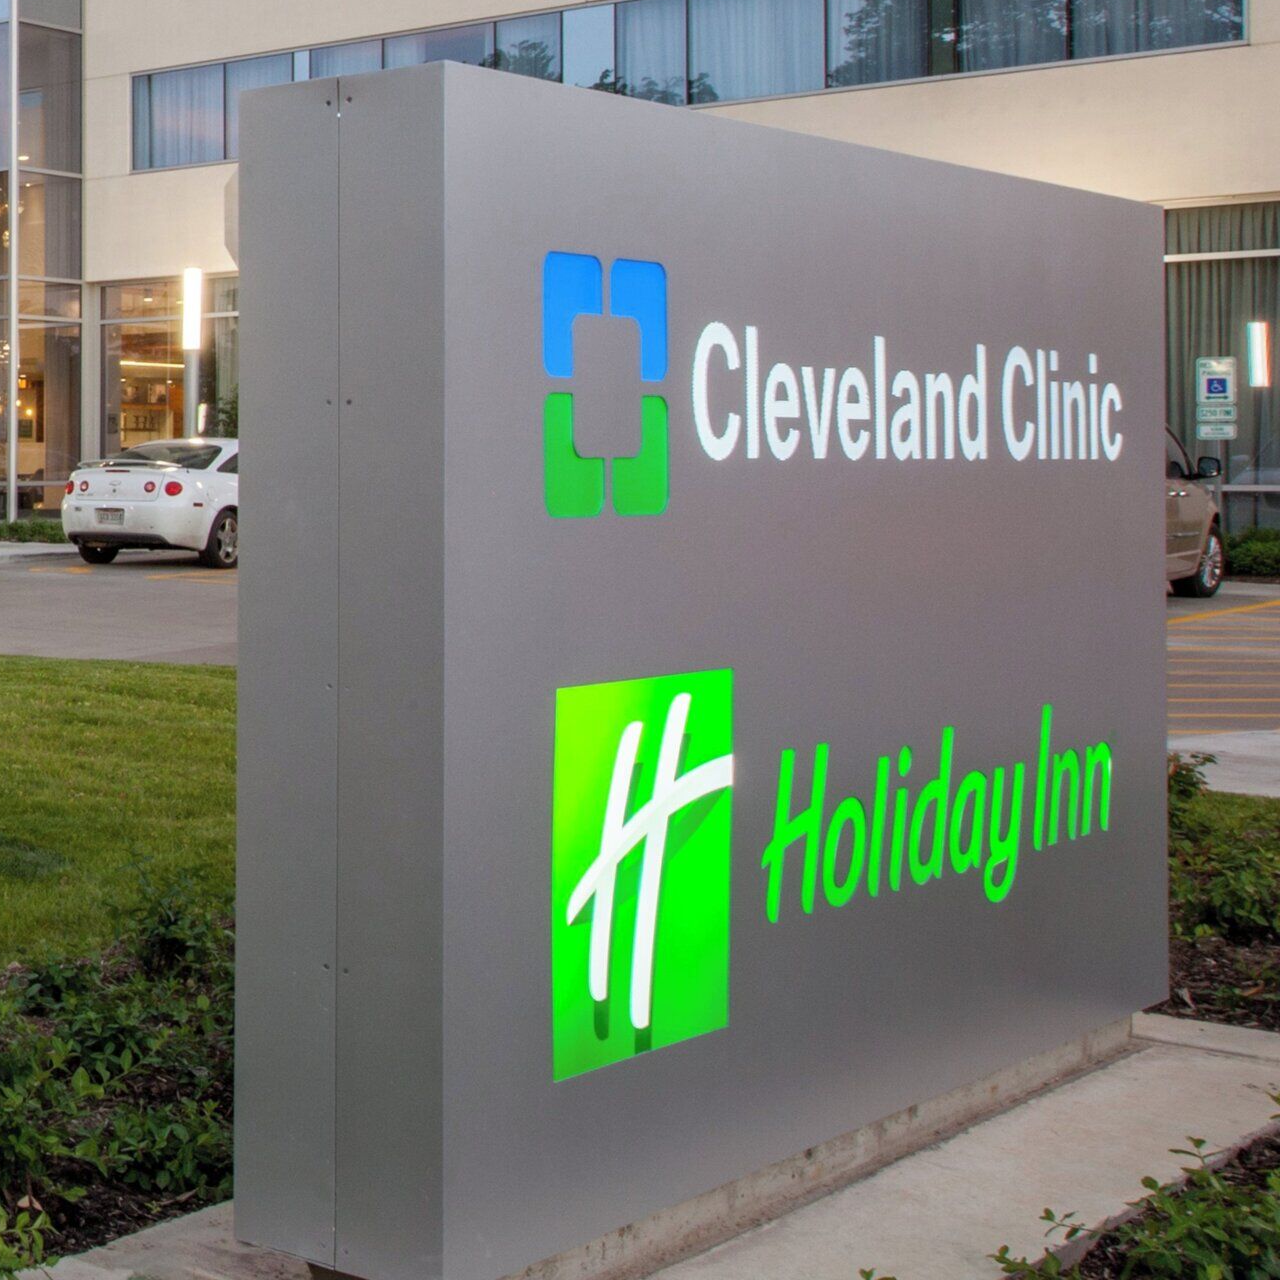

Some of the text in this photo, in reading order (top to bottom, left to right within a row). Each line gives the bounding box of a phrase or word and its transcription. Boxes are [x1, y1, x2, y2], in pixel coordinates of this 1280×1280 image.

[692, 320, 1123, 461] Cleveland Clinic
[761, 703, 1112, 924] Holiday Inn
